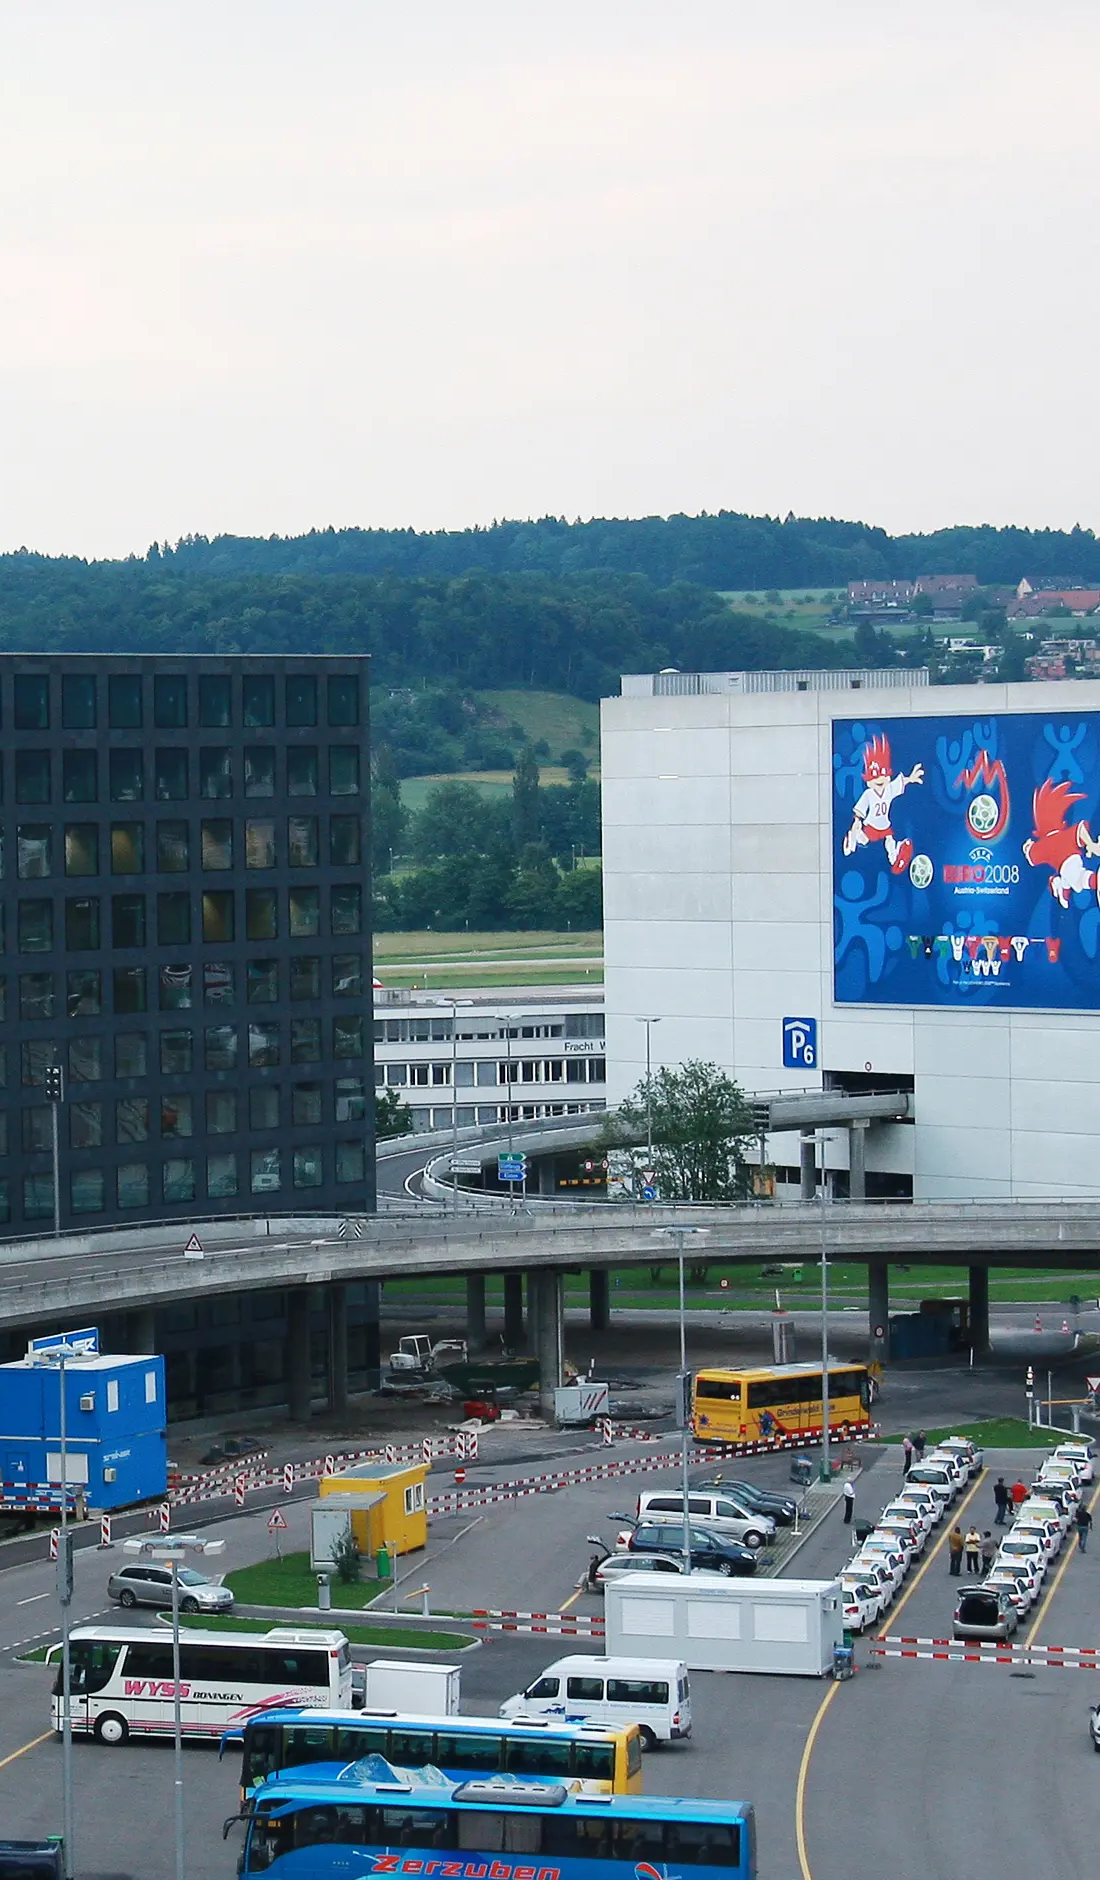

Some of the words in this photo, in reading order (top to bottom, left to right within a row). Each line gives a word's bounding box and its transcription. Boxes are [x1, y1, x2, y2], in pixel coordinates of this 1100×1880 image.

[874, 801, 888, 817] 20
[969, 849, 992, 861] UEFA
[564, 1041, 594, 1051] Fracht
[124, 1679, 192, 1698] WYSS
